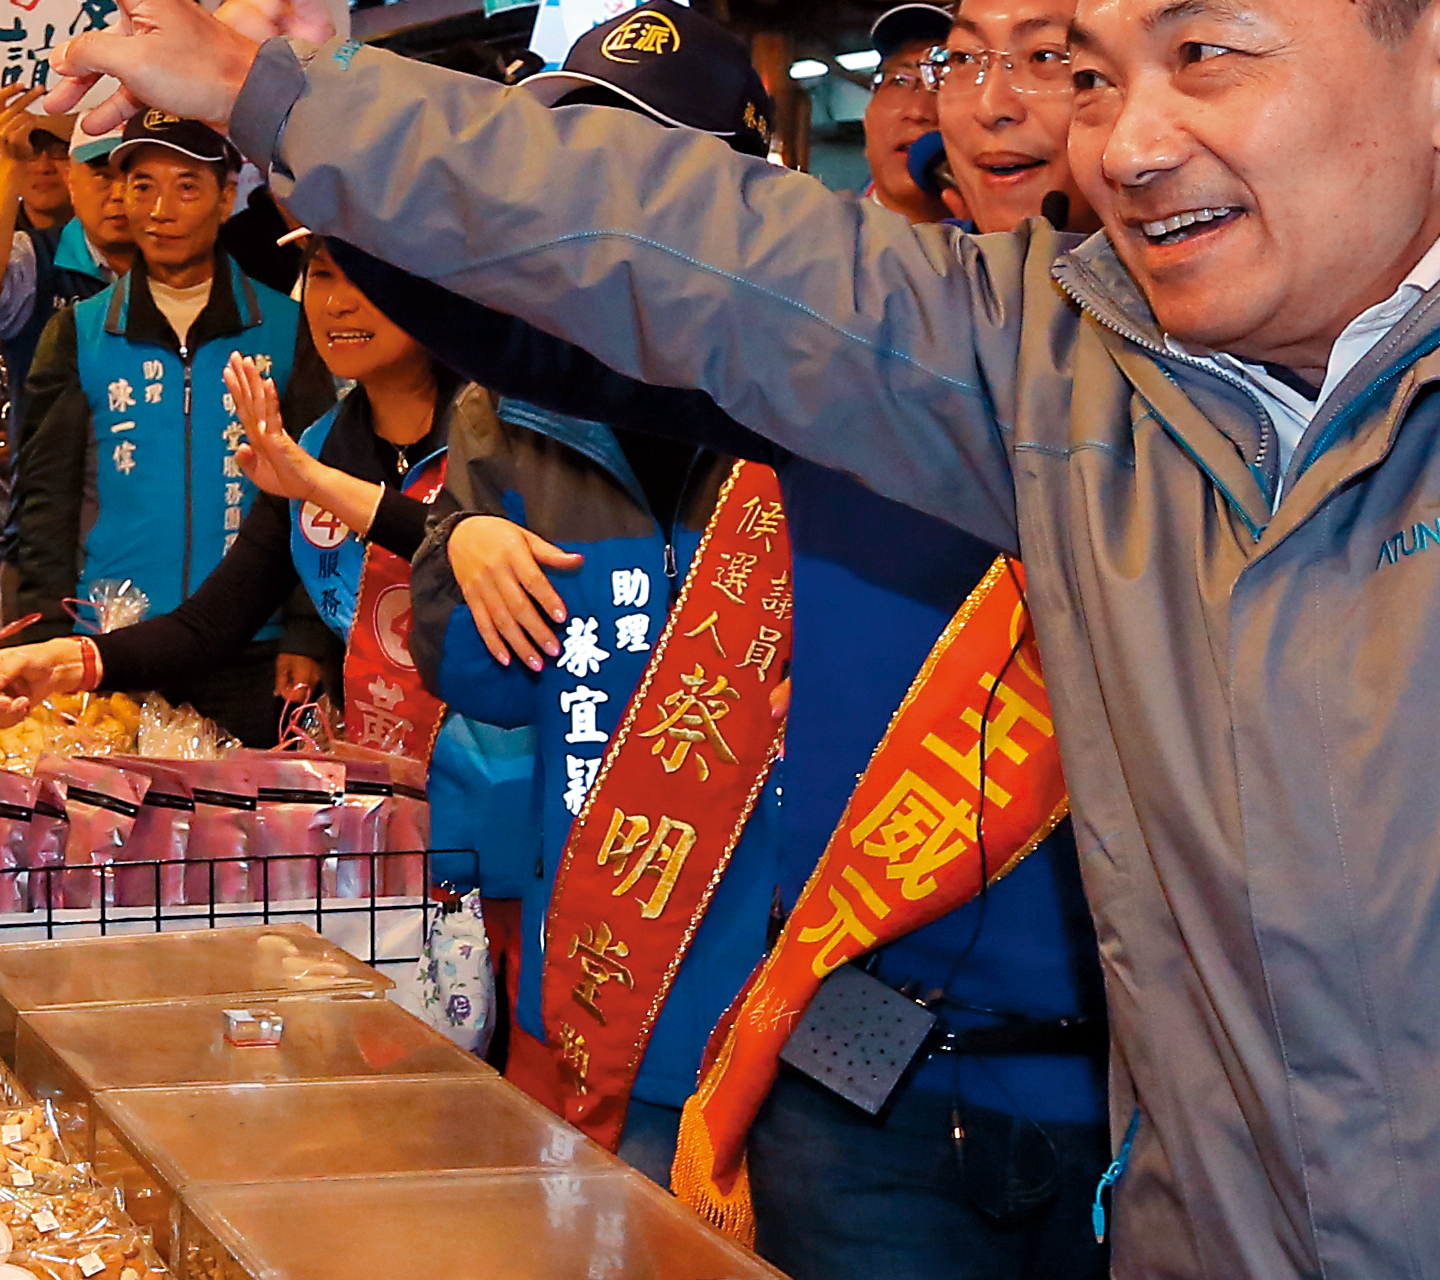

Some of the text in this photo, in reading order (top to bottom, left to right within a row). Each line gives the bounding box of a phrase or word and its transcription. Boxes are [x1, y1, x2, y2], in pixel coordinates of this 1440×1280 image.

[606, 21, 672, 56] 正派
[142, 359, 166, 405] 助理
[610, 568, 652, 654] 助理
[683, 496, 786, 659] 候選人
[566, 662, 741, 1028] 蔡明堂
[797, 670, 1055, 979] 王威元
